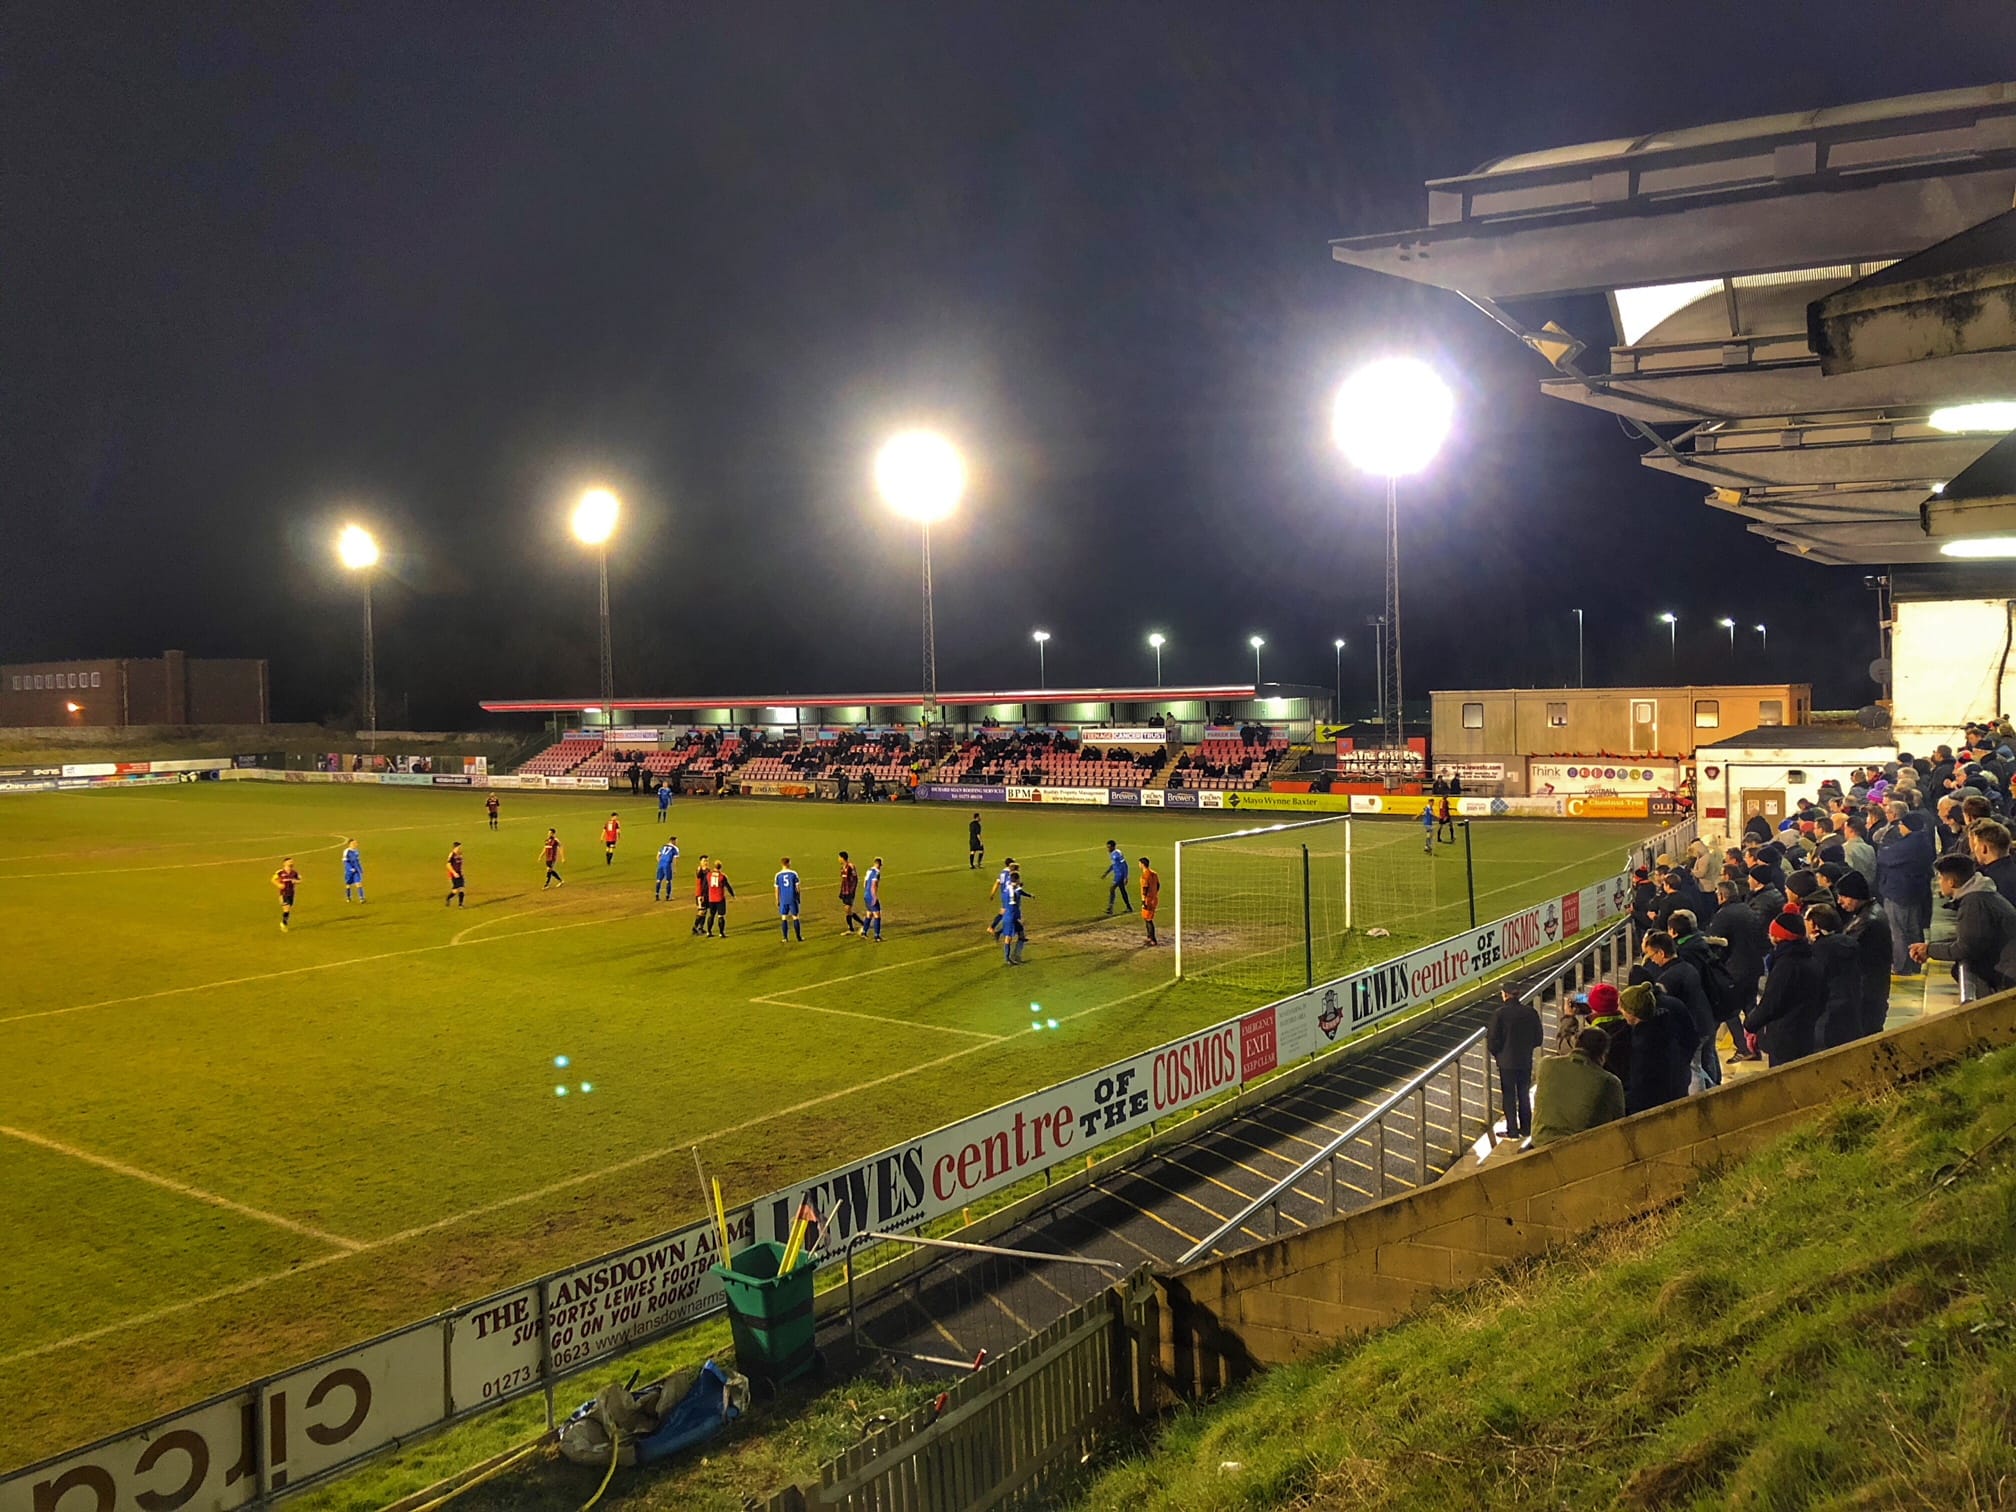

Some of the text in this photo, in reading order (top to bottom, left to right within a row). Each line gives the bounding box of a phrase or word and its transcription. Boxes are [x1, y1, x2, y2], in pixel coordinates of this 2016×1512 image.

[1531, 766, 1561, 777] Think
[1008, 788, 1031, 798] BPM
[1111, 791, 1138, 800] Brewers
[1167, 793, 1196, 802] Brewers
[1243, 797, 1318, 806] Mayo Wynne Baxter
[783, 875, 789, 886] 5
[1477, 930, 1495, 950] OF
[1502, 910, 1540, 960] COSMOS
[1471, 948, 1501, 972] THE
[1351, 949, 1469, 1022] LEWES centre
[1241, 1016, 1274, 1037] EMERGENCY
[1246, 1032, 1271, 1058] EXIT
[1153, 1029, 1235, 1110] COSMOS
[1243, 1055, 1276, 1075] KEEP CLEAR
[1095, 1068, 1135, 1104] OF
[1079, 1089, 1149, 1138] THE
[773, 1105, 1073, 1251] LEWES centre
[604, 1276, 656, 1310] LEWES
[471, 1296, 530, 1339] THE
[551, 1280, 700, 1350] GO ON YOU ROOKS!
[482, 1369, 531, 1398] 01273
[535, 1341, 590, 1378] 40623
